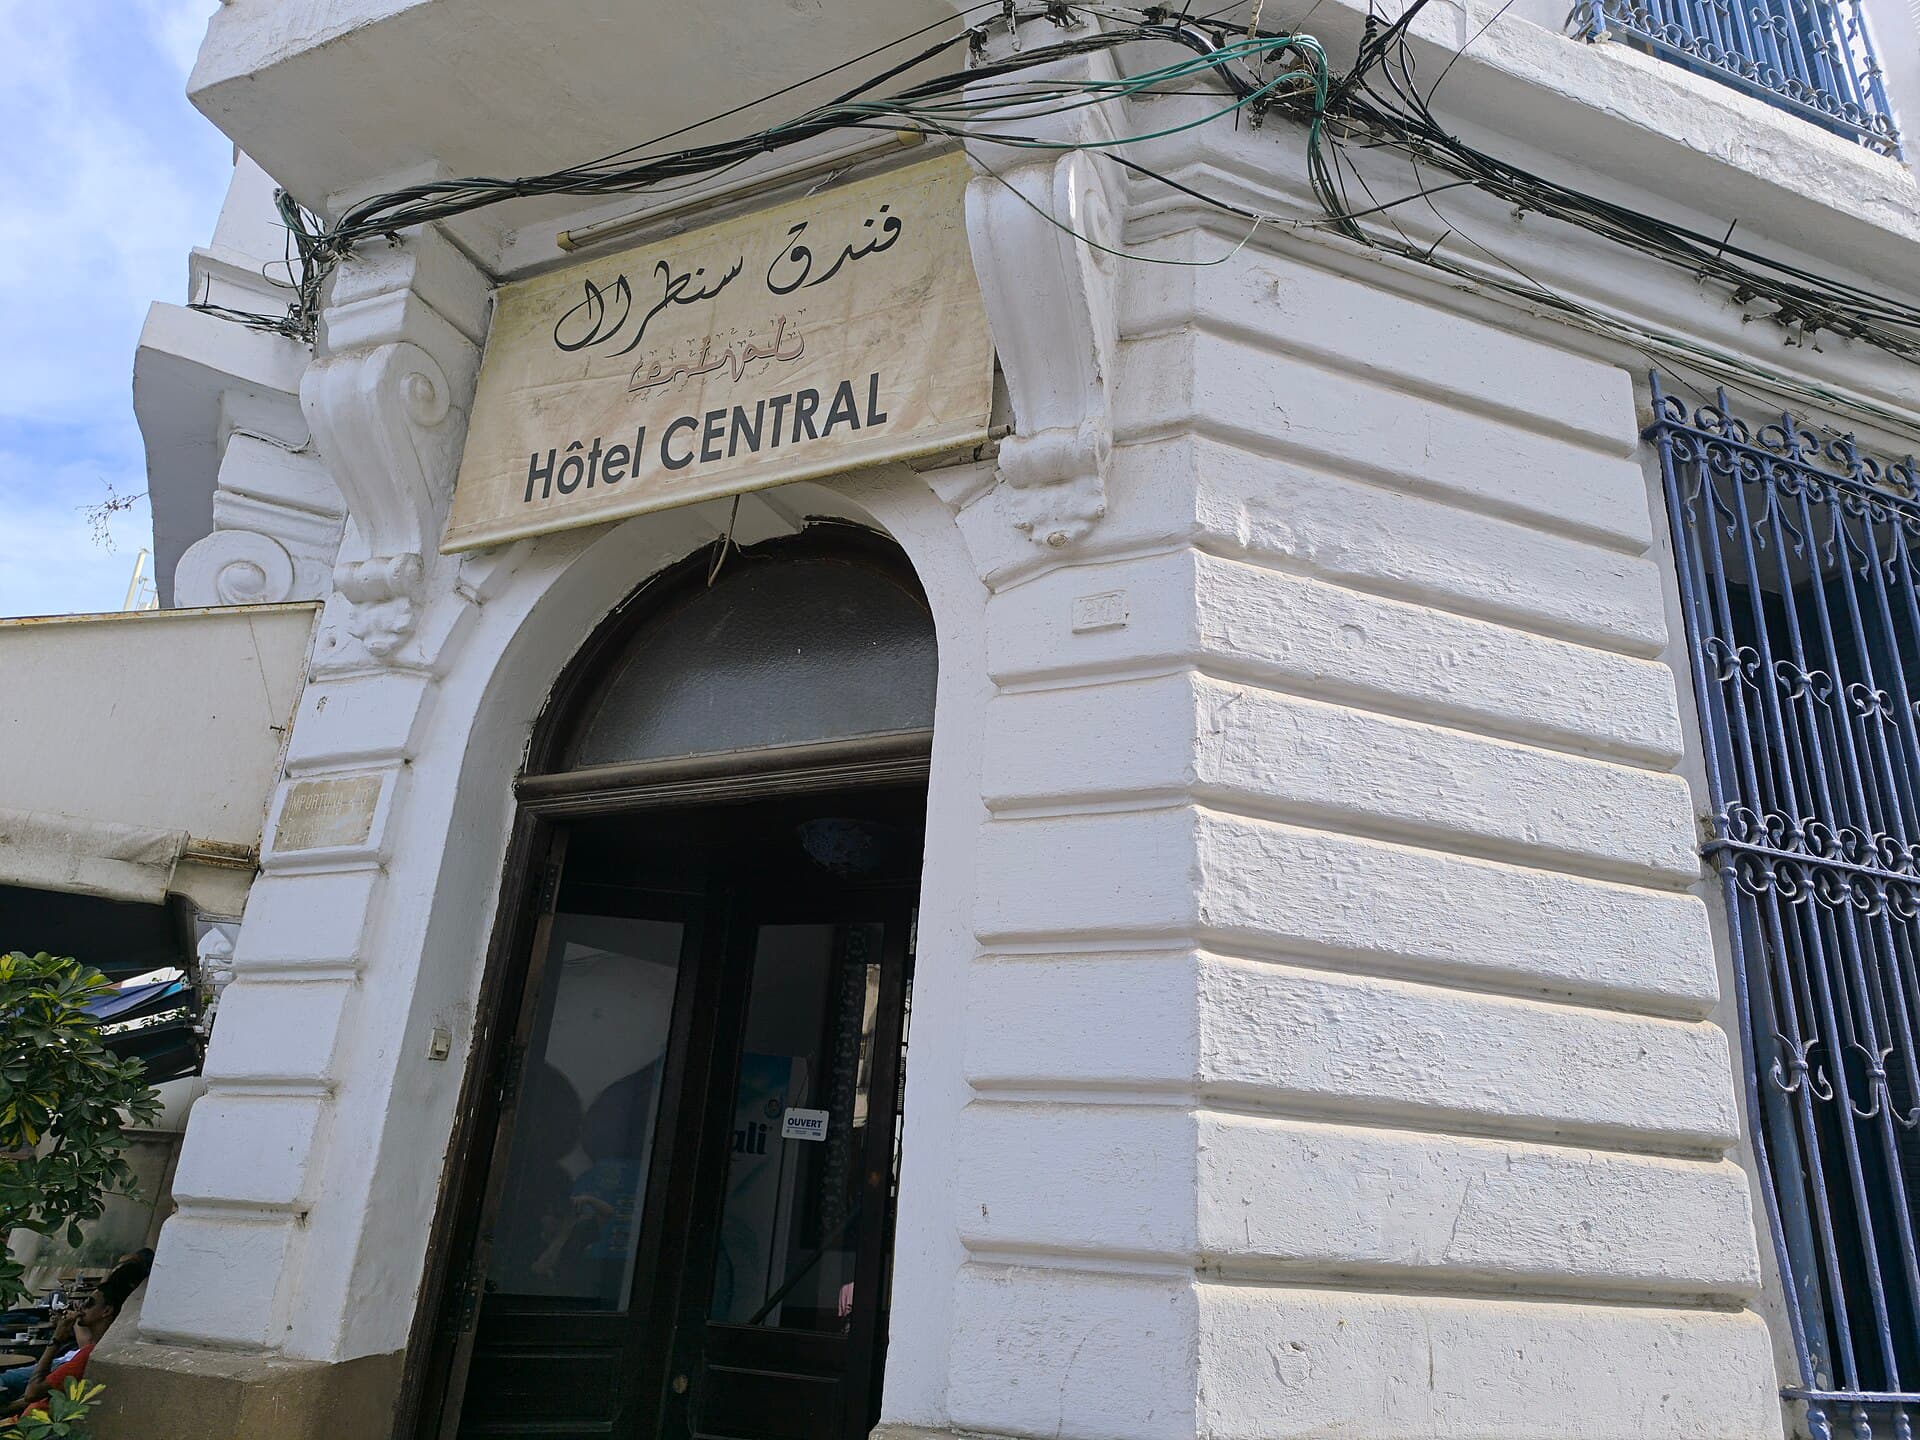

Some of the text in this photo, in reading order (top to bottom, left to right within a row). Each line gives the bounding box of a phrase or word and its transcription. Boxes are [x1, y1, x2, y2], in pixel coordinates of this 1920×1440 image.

[554, 204, 902, 359] فندق سنطرال
[523, 372, 888, 503] Hôtel CENTRAL
[787, 1117, 823, 1129] OUVERT
